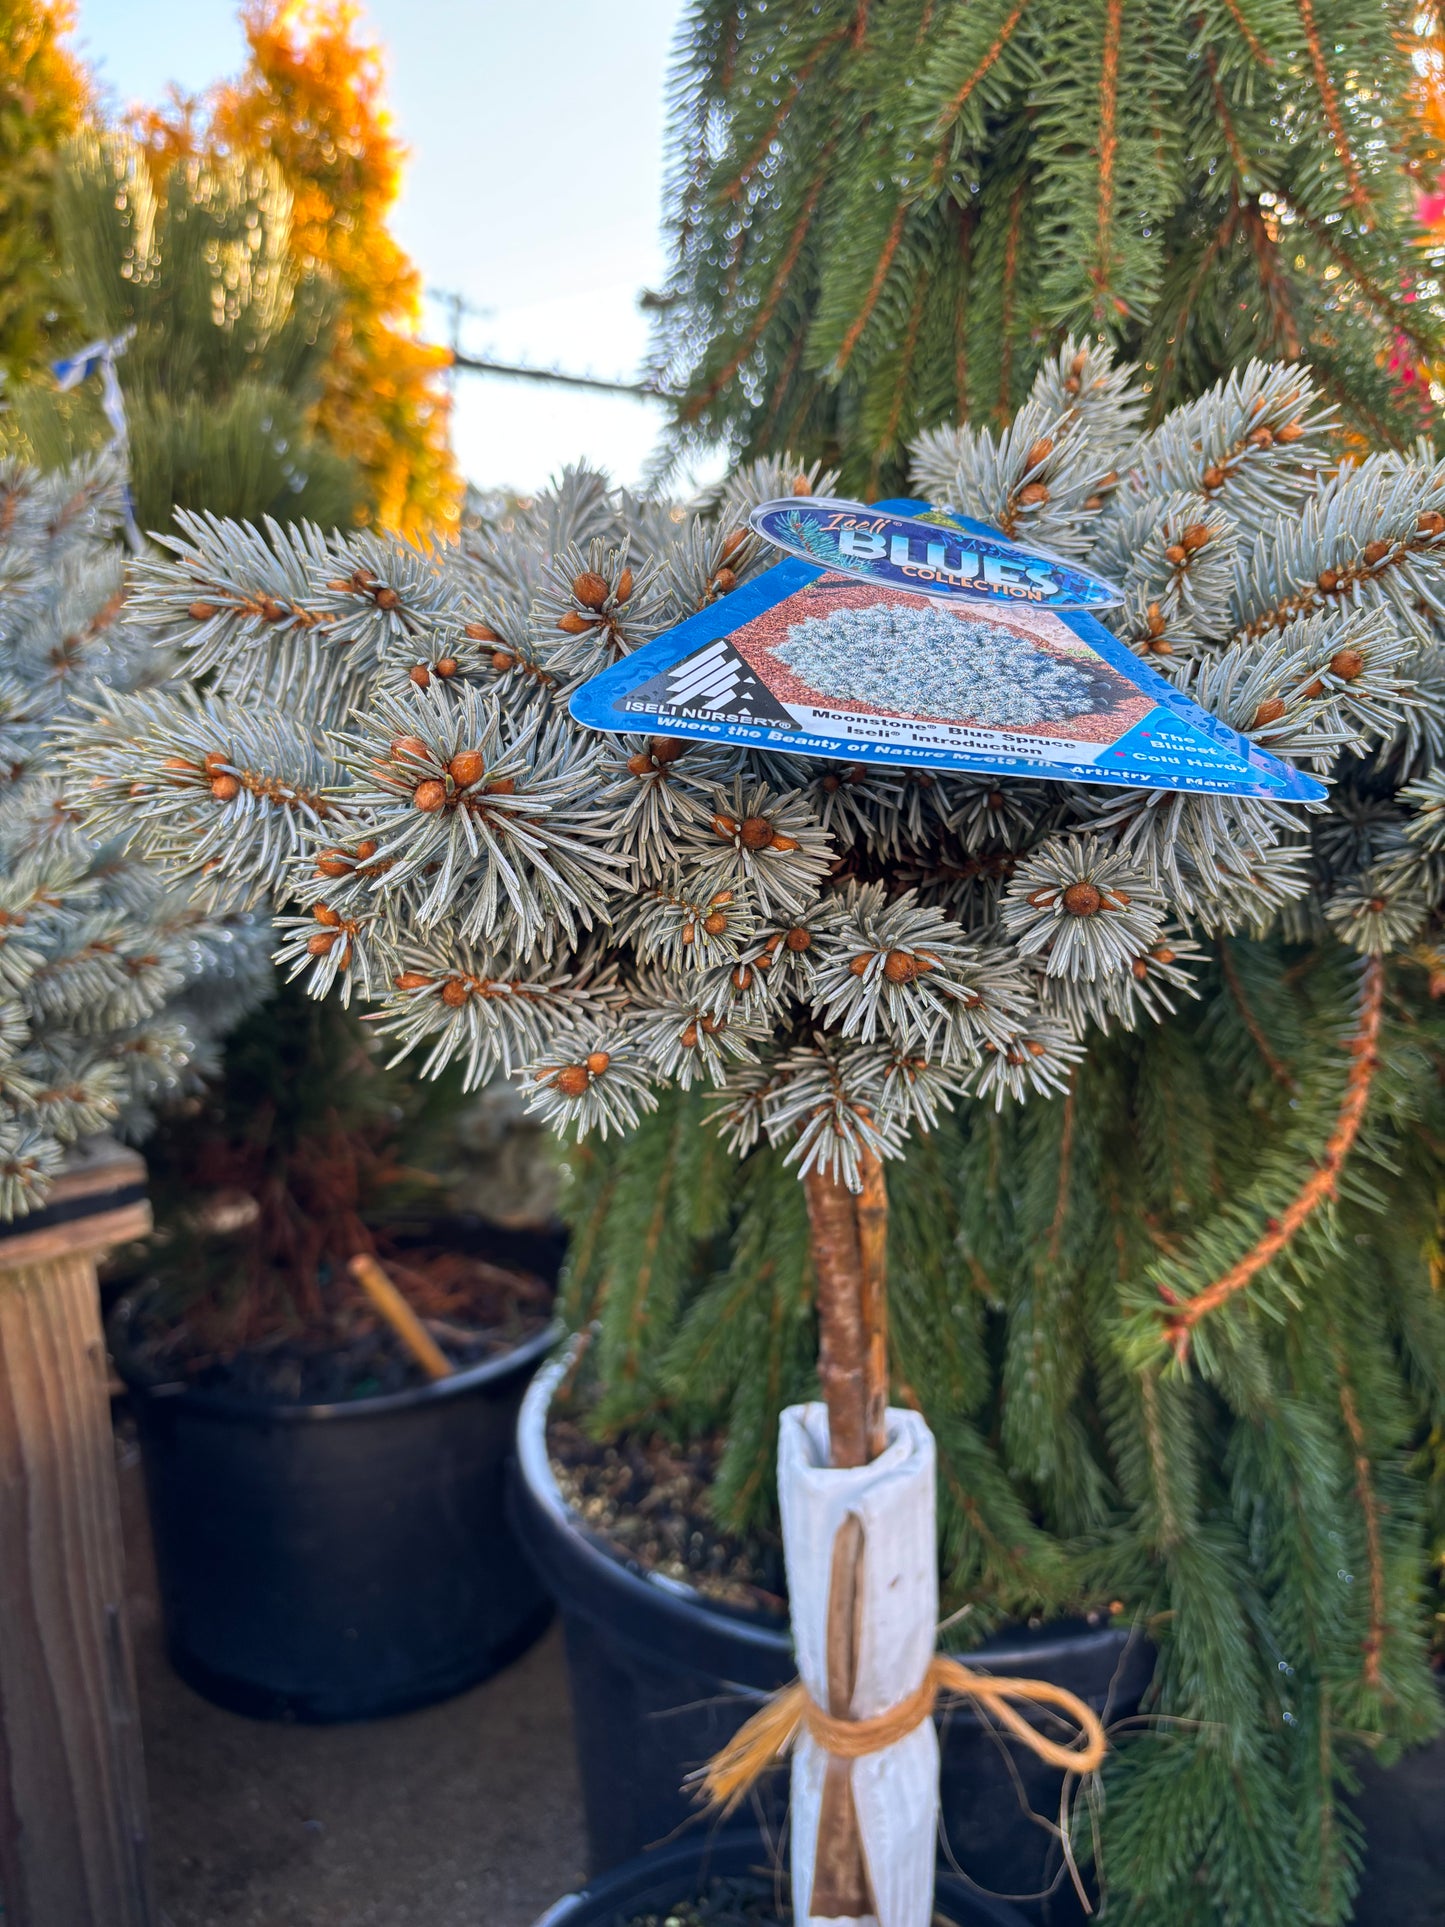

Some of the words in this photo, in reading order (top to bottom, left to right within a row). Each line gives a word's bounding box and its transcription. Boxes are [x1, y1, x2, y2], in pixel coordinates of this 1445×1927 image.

[839, 529, 1060, 595] BLUES
[902, 566, 1042, 601] COLLECTION
[625, 701, 676, 716] ISELI
[656, 717, 721, 733] Where
[727, 726, 762, 739] the
[767, 730, 842, 750] Beauty
[847, 743, 870, 753] of
[874, 745, 946, 760] Nature
[912, 733, 1043, 755] Introduction
[948, 727, 995, 739] Blue
[1002, 734, 1076, 749] Spruce
[1150, 740, 1218, 756] Bluest
[1155, 732, 1196, 744] The
[1132, 752, 1181, 765] Cold
[1187, 758, 1248, 774] Hardy
